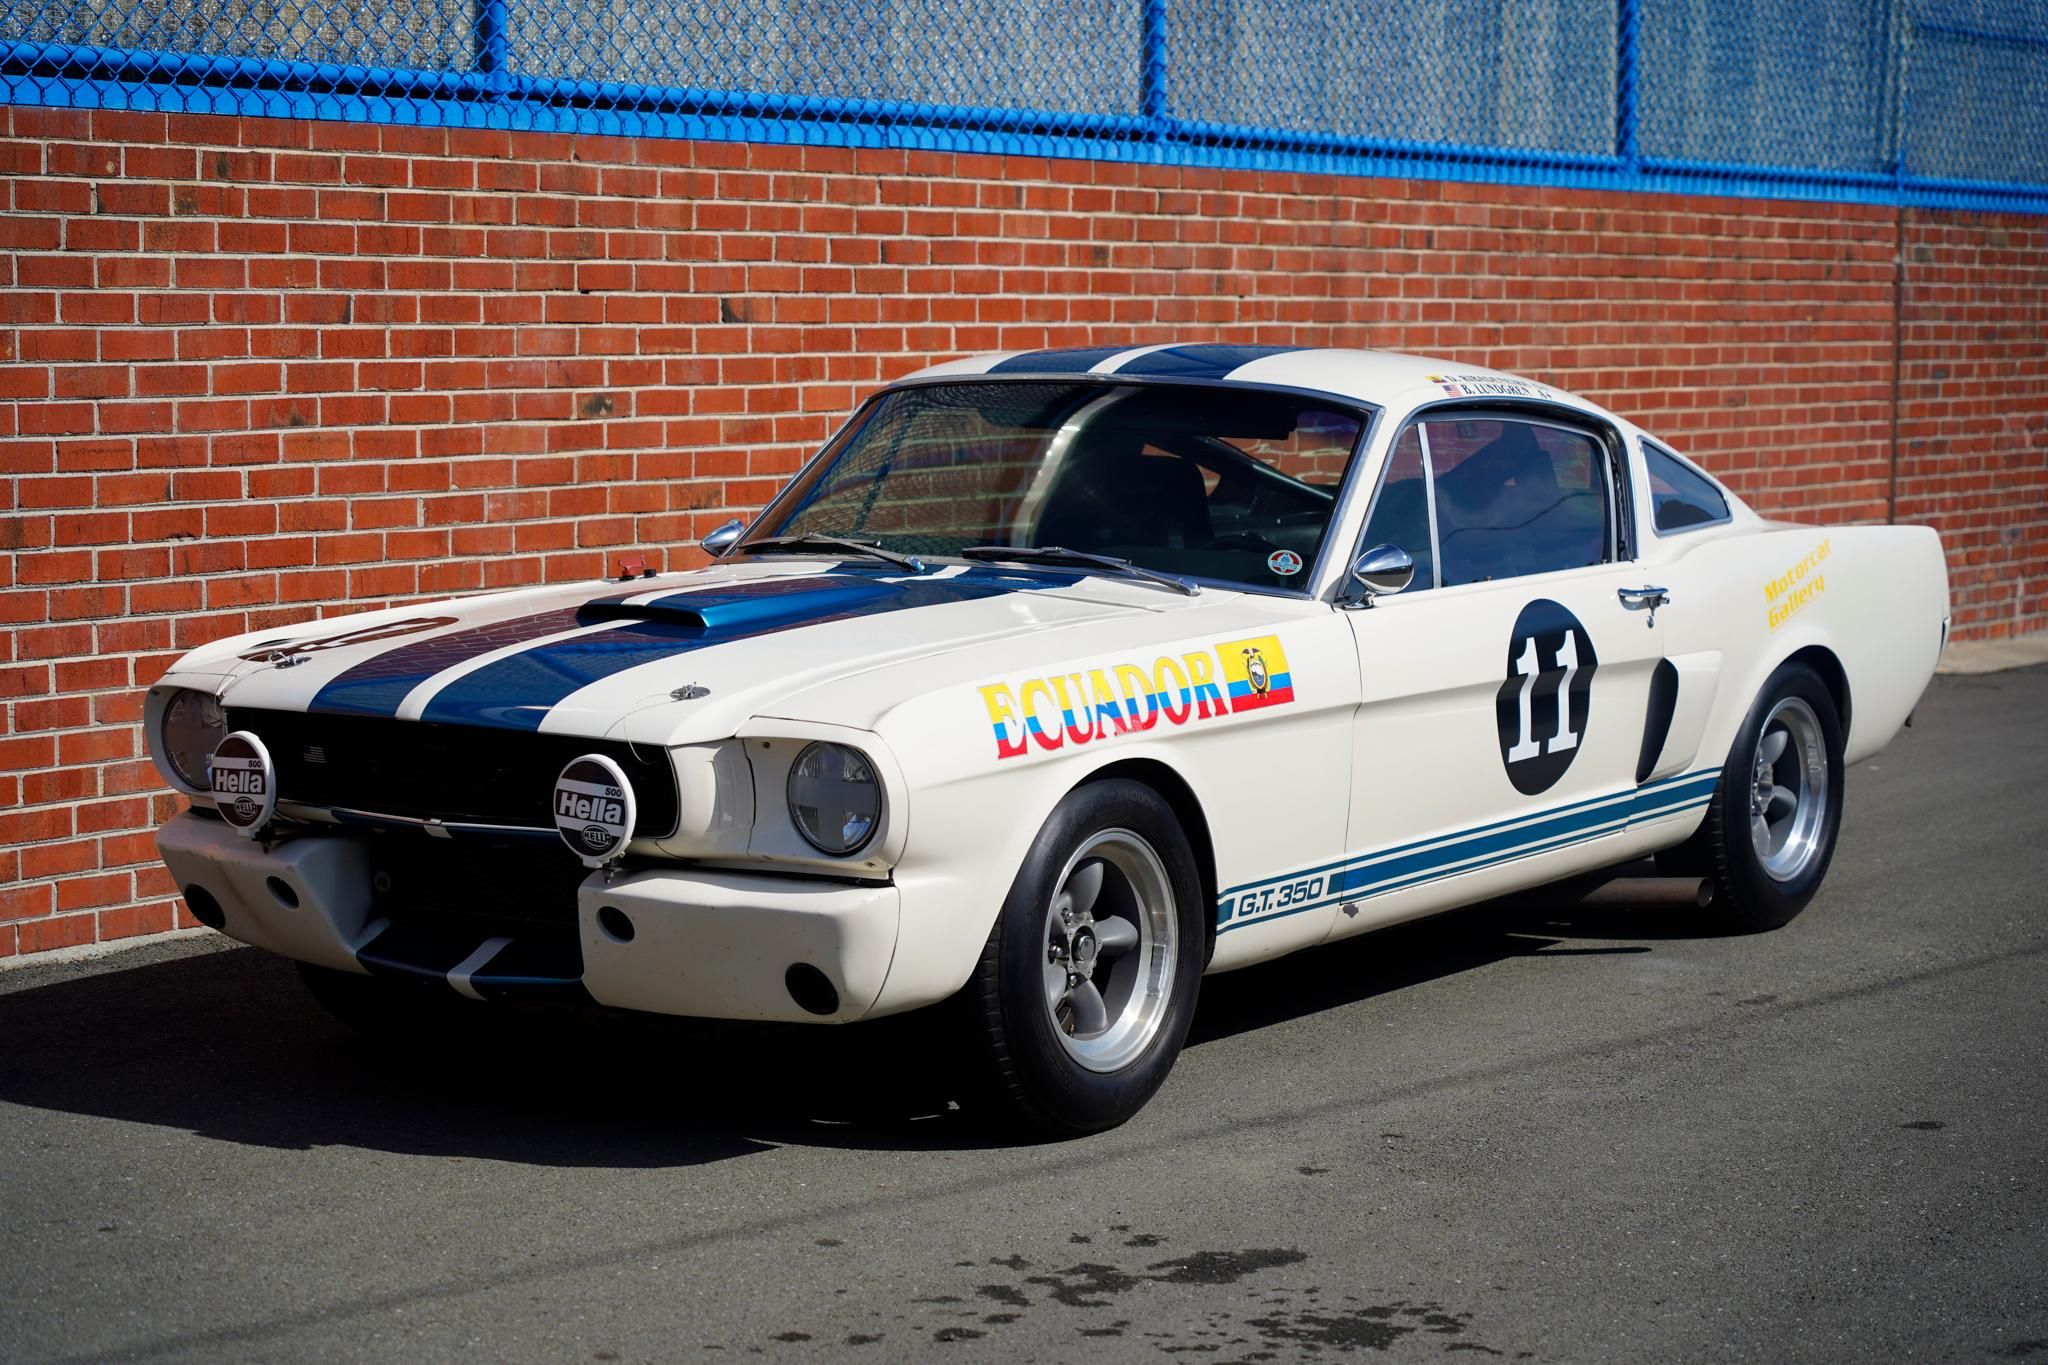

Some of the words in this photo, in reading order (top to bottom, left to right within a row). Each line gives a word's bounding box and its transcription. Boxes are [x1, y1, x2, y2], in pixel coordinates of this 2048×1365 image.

[1768, 575, 1825, 629] Gallery
[976, 651, 1230, 760] ECUADOR
[1508, 630, 1578, 764] 11
[248, 760, 262, 768] 500
[215, 769, 262, 793] Hella
[605, 787, 622, 797] 500
[559, 792, 622, 823] Hella
